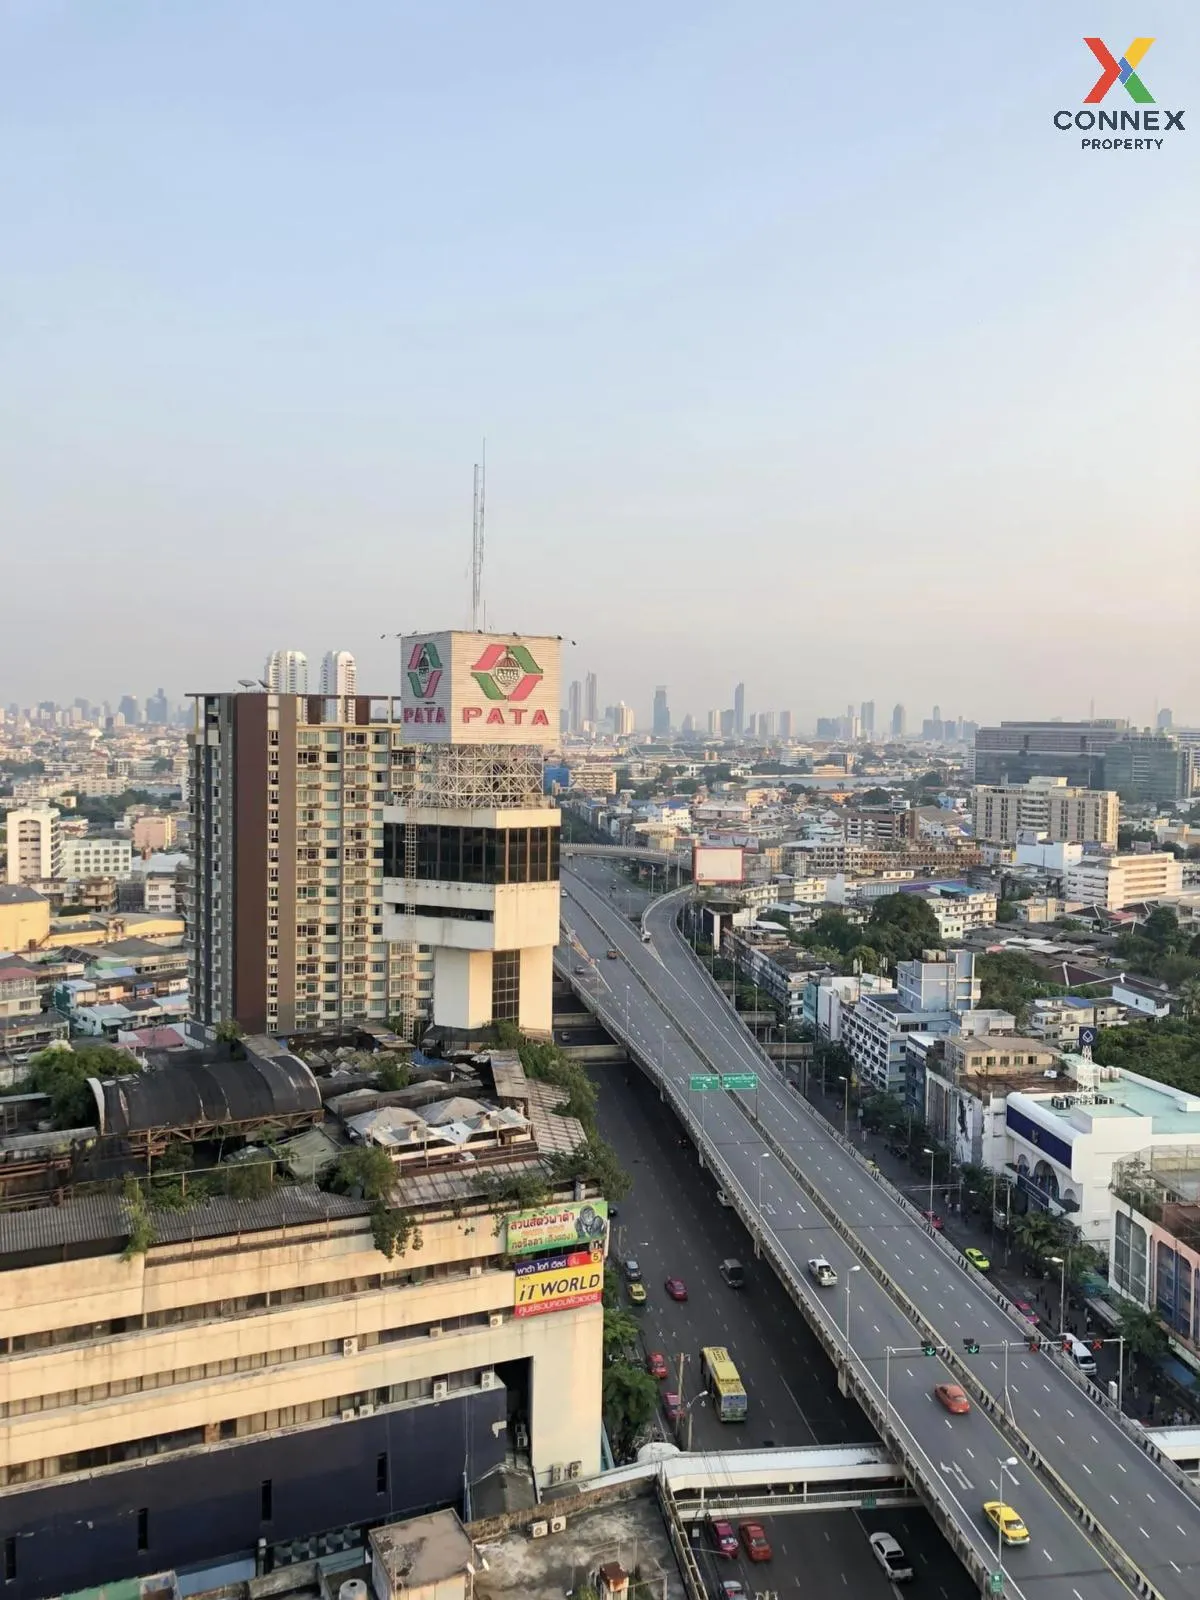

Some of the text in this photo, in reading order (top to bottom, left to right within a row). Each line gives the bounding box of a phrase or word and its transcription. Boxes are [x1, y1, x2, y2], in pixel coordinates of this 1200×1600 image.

[403, 706, 446, 724] PATA
[462, 706, 549, 726] PATA
[592, 1252, 599, 1261] 5
[540, 1273, 600, 1297] WORLD
